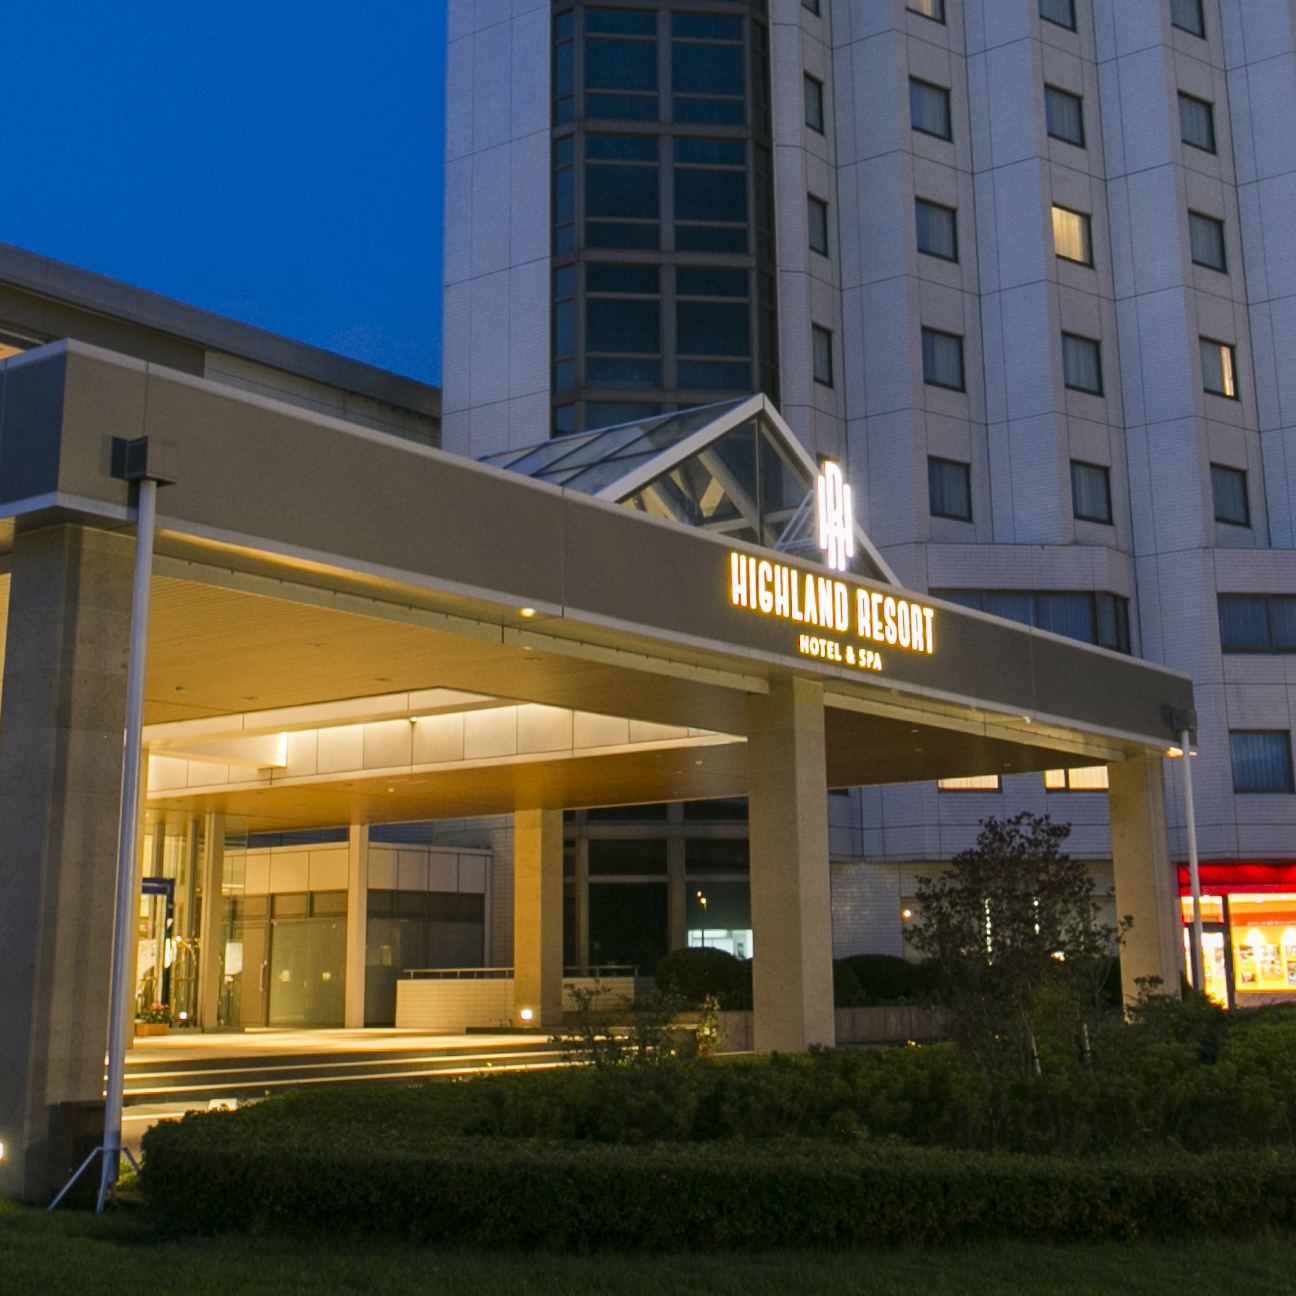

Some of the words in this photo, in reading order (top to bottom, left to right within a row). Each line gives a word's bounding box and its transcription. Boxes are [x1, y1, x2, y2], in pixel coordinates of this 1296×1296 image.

[730, 552, 849, 632] HIGHLAND
[856, 588, 935, 654] RESORT
[799, 634, 842, 662] HOTEL
[845, 645, 856, 665] &
[858, 648, 883, 671] SPA
